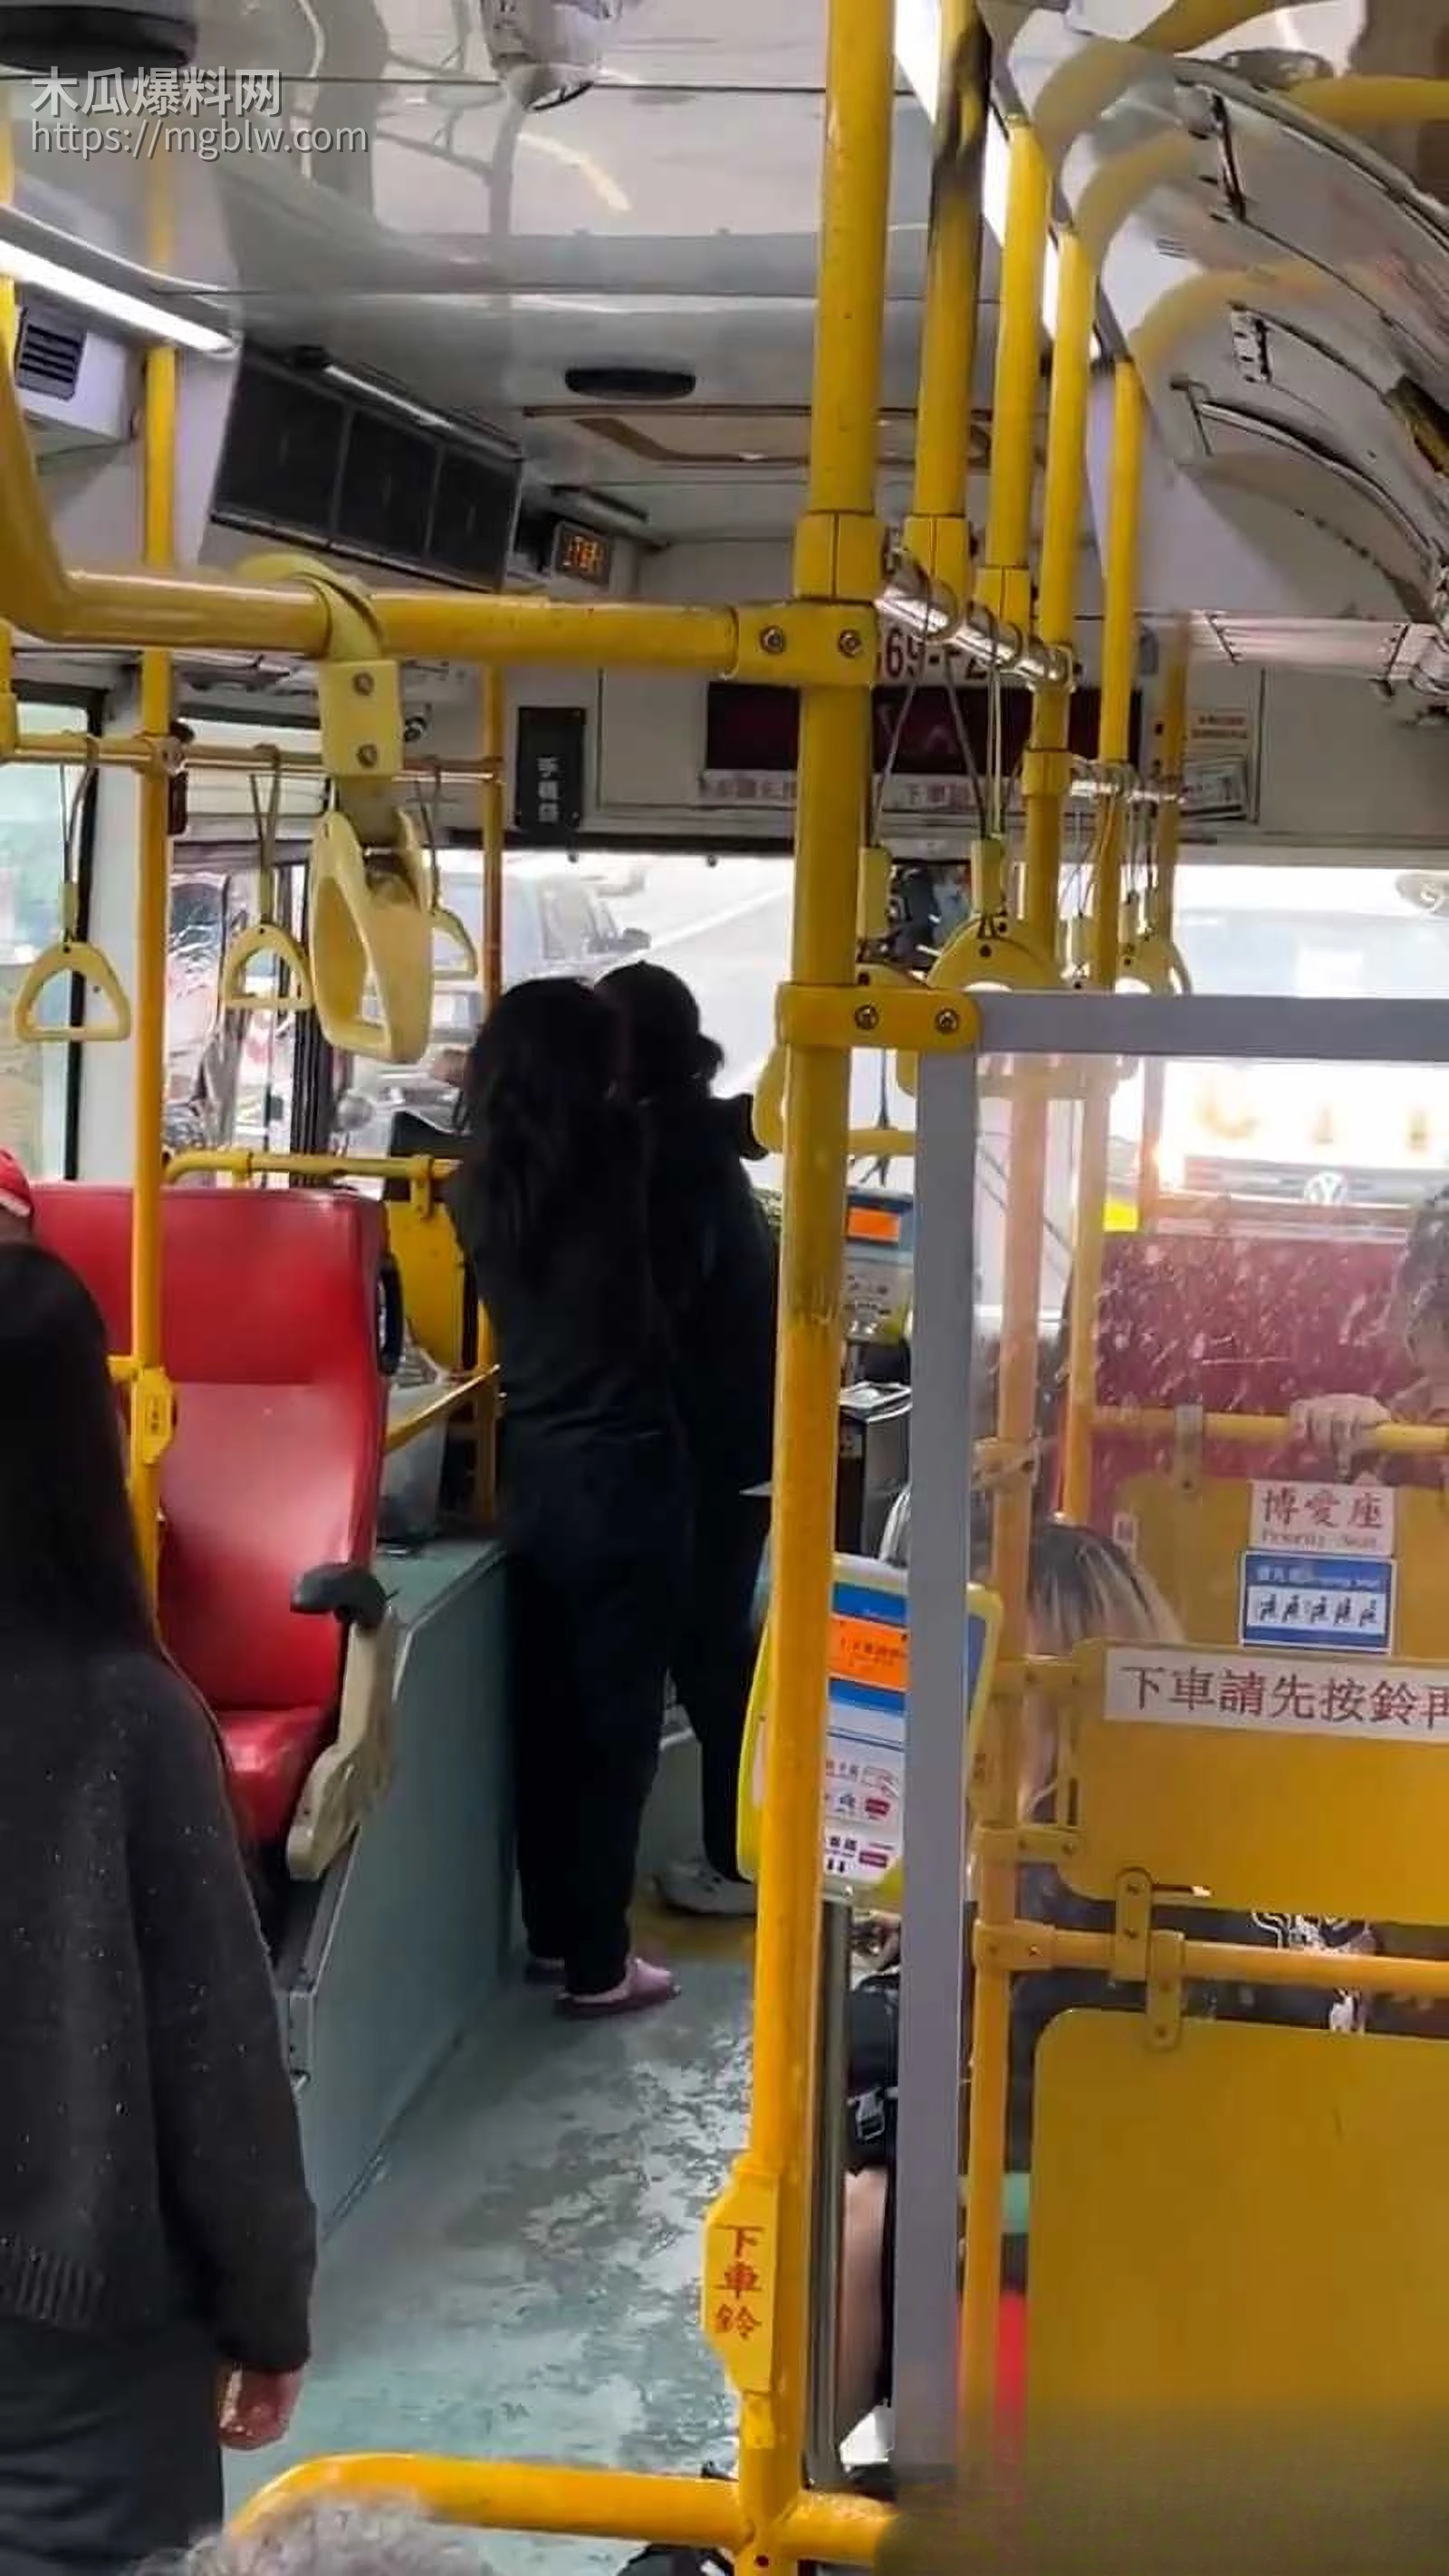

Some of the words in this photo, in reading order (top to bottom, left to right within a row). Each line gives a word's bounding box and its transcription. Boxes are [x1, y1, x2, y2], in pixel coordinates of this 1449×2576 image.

[1261, 1486, 1384, 1529] 博愛座
[714, 2223, 764, 2341] 下車鈴
